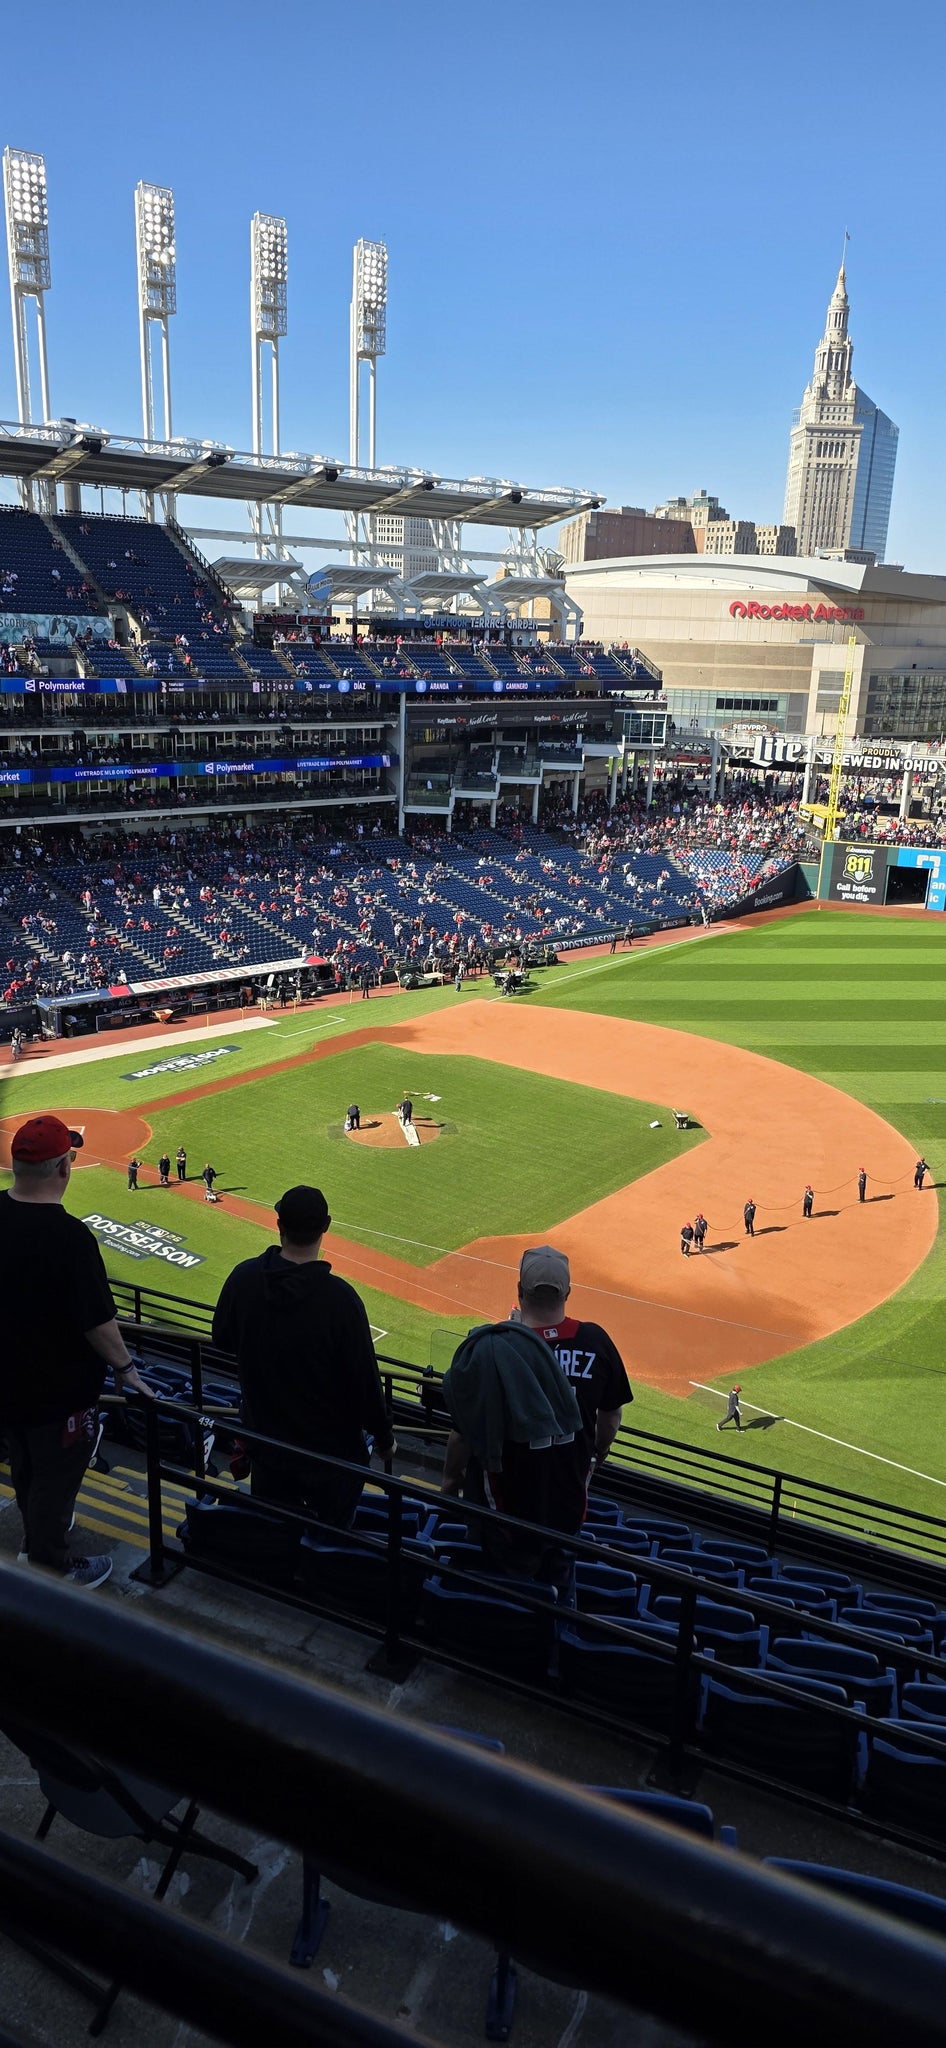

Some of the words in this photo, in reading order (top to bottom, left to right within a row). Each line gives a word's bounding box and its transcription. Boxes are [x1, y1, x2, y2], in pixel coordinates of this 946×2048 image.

[747, 601, 811, 618] Rocket
[814, 603, 865, 620] Arena
[471, 617, 505, 629] TERRACE
[507, 620, 538, 630] GARDEN
[39, 681, 85, 691] Polymarket
[353, 681, 366, 690] DÍAZ
[733, 723, 767, 731] SERVPRO
[750, 735, 802, 767] Lite
[862, 747, 900, 757] PROUDLY
[124, 767, 157, 775] POLYMARKET
[216, 762, 255, 771] Polymarket
[885, 758, 900, 770] IN
[903, 759, 938, 773] OHIO
[846, 855, 871, 873] 811
[836, 882, 851, 891] Call
[852, 883, 877, 894] before
[754, 891, 783, 907] Booking.com
[841, 892, 855, 900] you
[855, 893, 870, 902] dig.
[141, 969, 249, 992] CLEVELAND
[131, 1048, 230, 1077] POSTSEASON
[81, 1214, 200, 1267] POSTSEASON
[103, 1239, 141, 1258] Booking.com
[199, 1417, 215, 1429] 434
